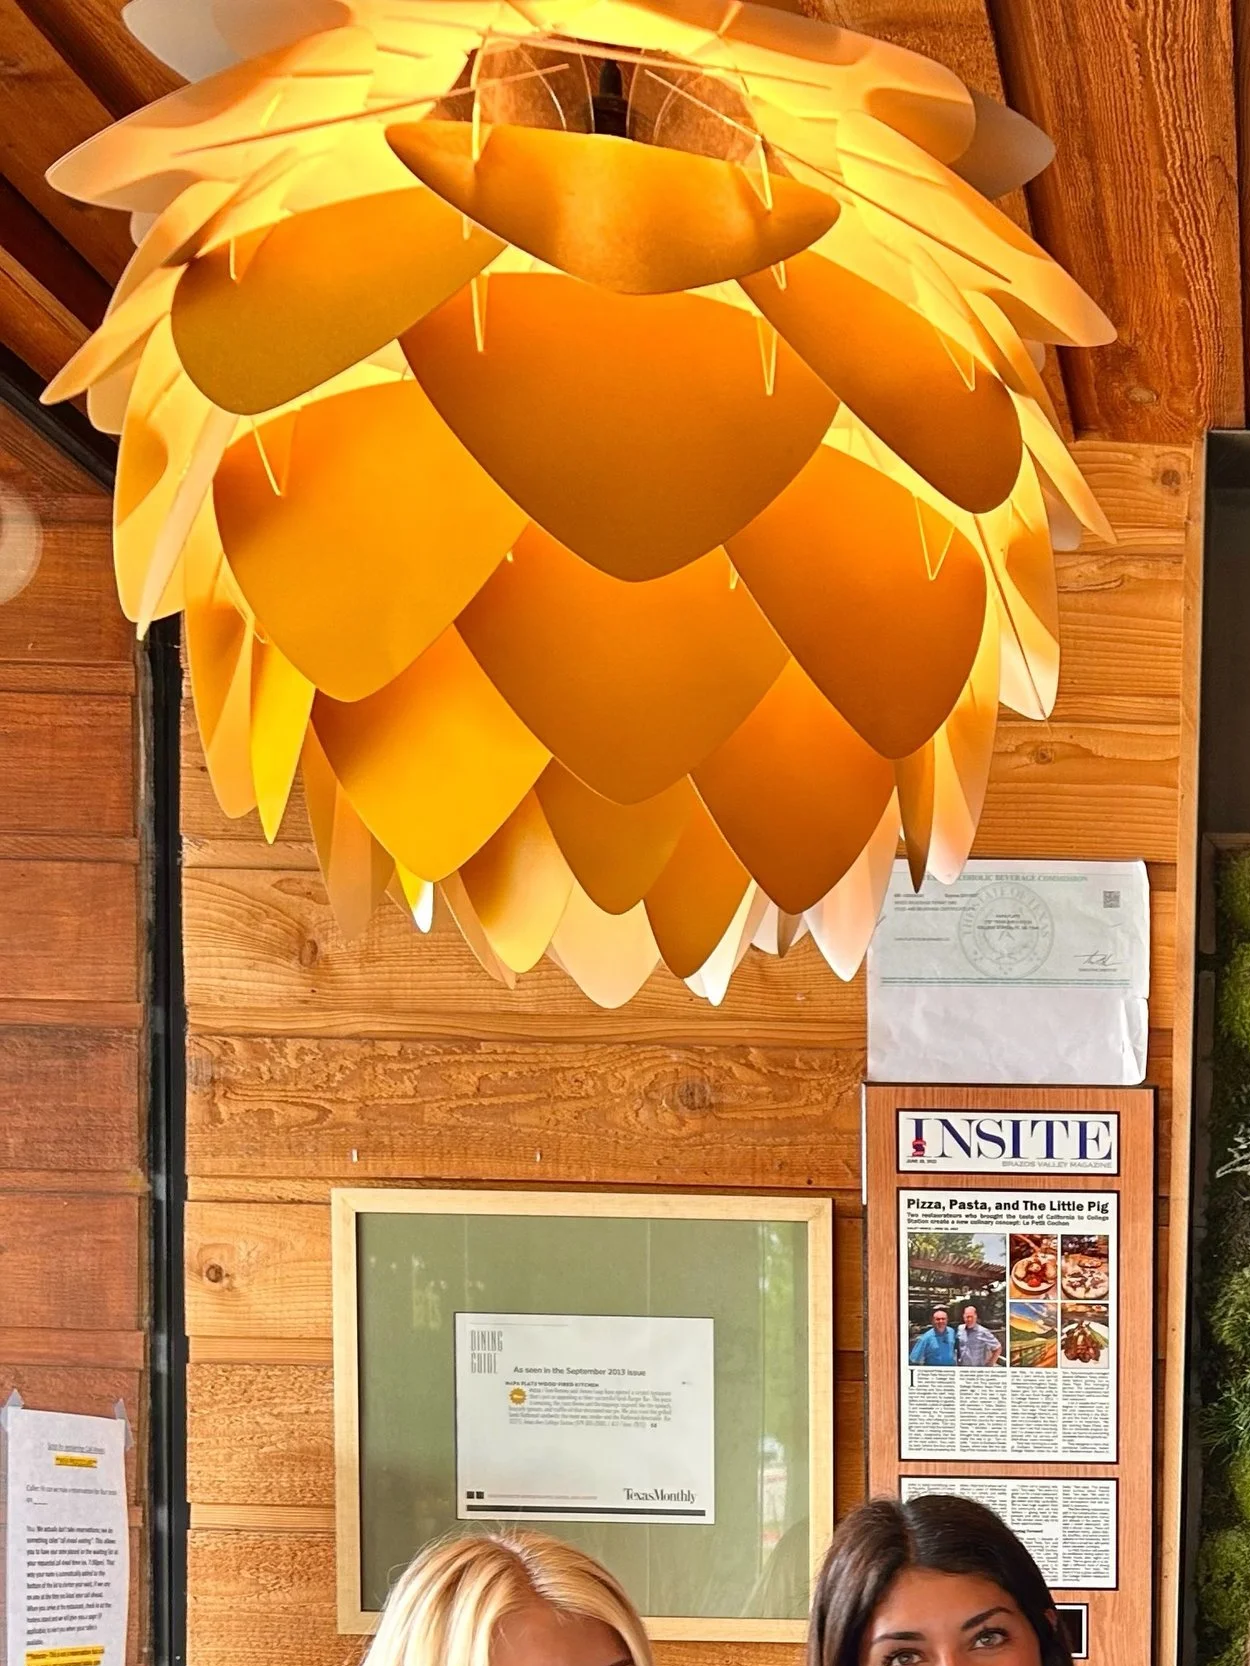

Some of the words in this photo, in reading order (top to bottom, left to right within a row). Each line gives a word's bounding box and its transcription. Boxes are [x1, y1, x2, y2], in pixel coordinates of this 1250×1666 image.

[906, 1118, 1113, 1160] INSITE
[907, 1199, 946, 1211] Pizza,
[949, 1199, 992, 1212] Pasta,
[995, 1200, 1019, 1210] and
[1022, 1200, 1046, 1211] The
[1049, 1201, 1084, 1211] Little
[1088, 1201, 1109, 1213] Pig
[470, 1330, 503, 1352] DINING
[470, 1353, 499, 1374] GUIDE
[566, 1368, 606, 1376] September
